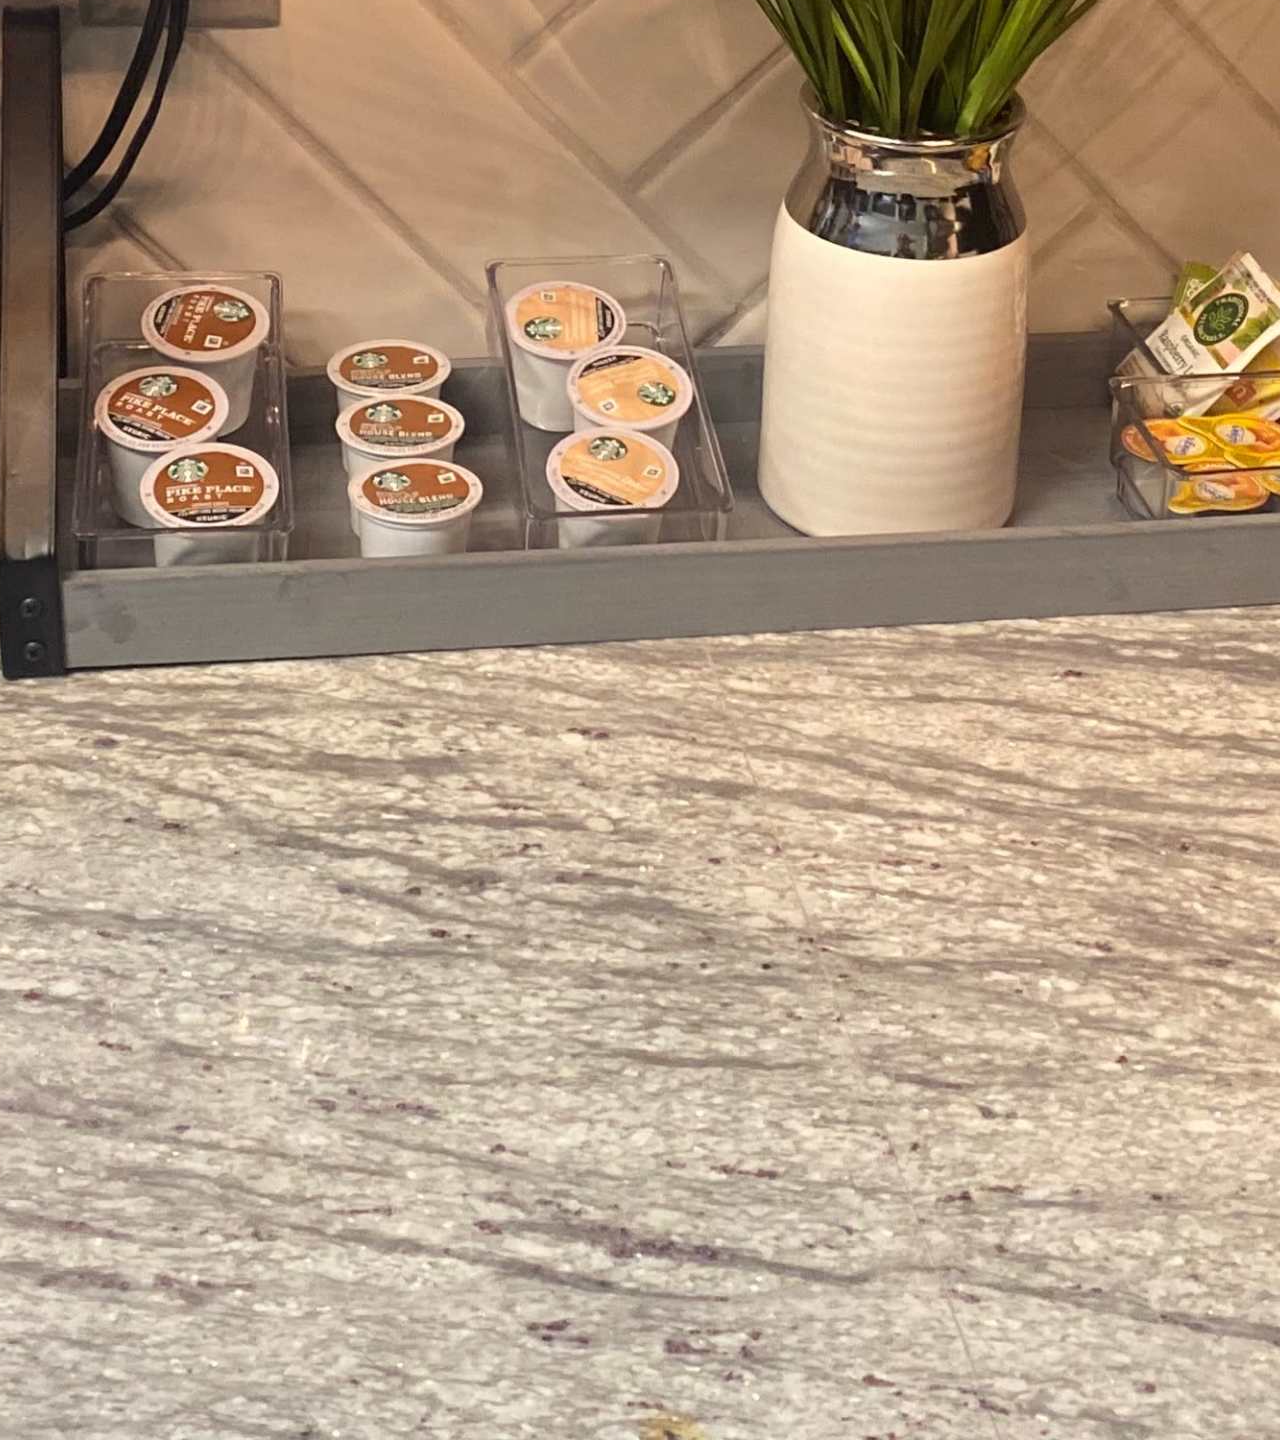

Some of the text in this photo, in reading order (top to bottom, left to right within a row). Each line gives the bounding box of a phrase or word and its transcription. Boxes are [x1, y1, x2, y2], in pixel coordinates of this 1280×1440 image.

[151, 404, 193, 426] PLACE
[166, 484, 252, 498] PIKE PLACE
